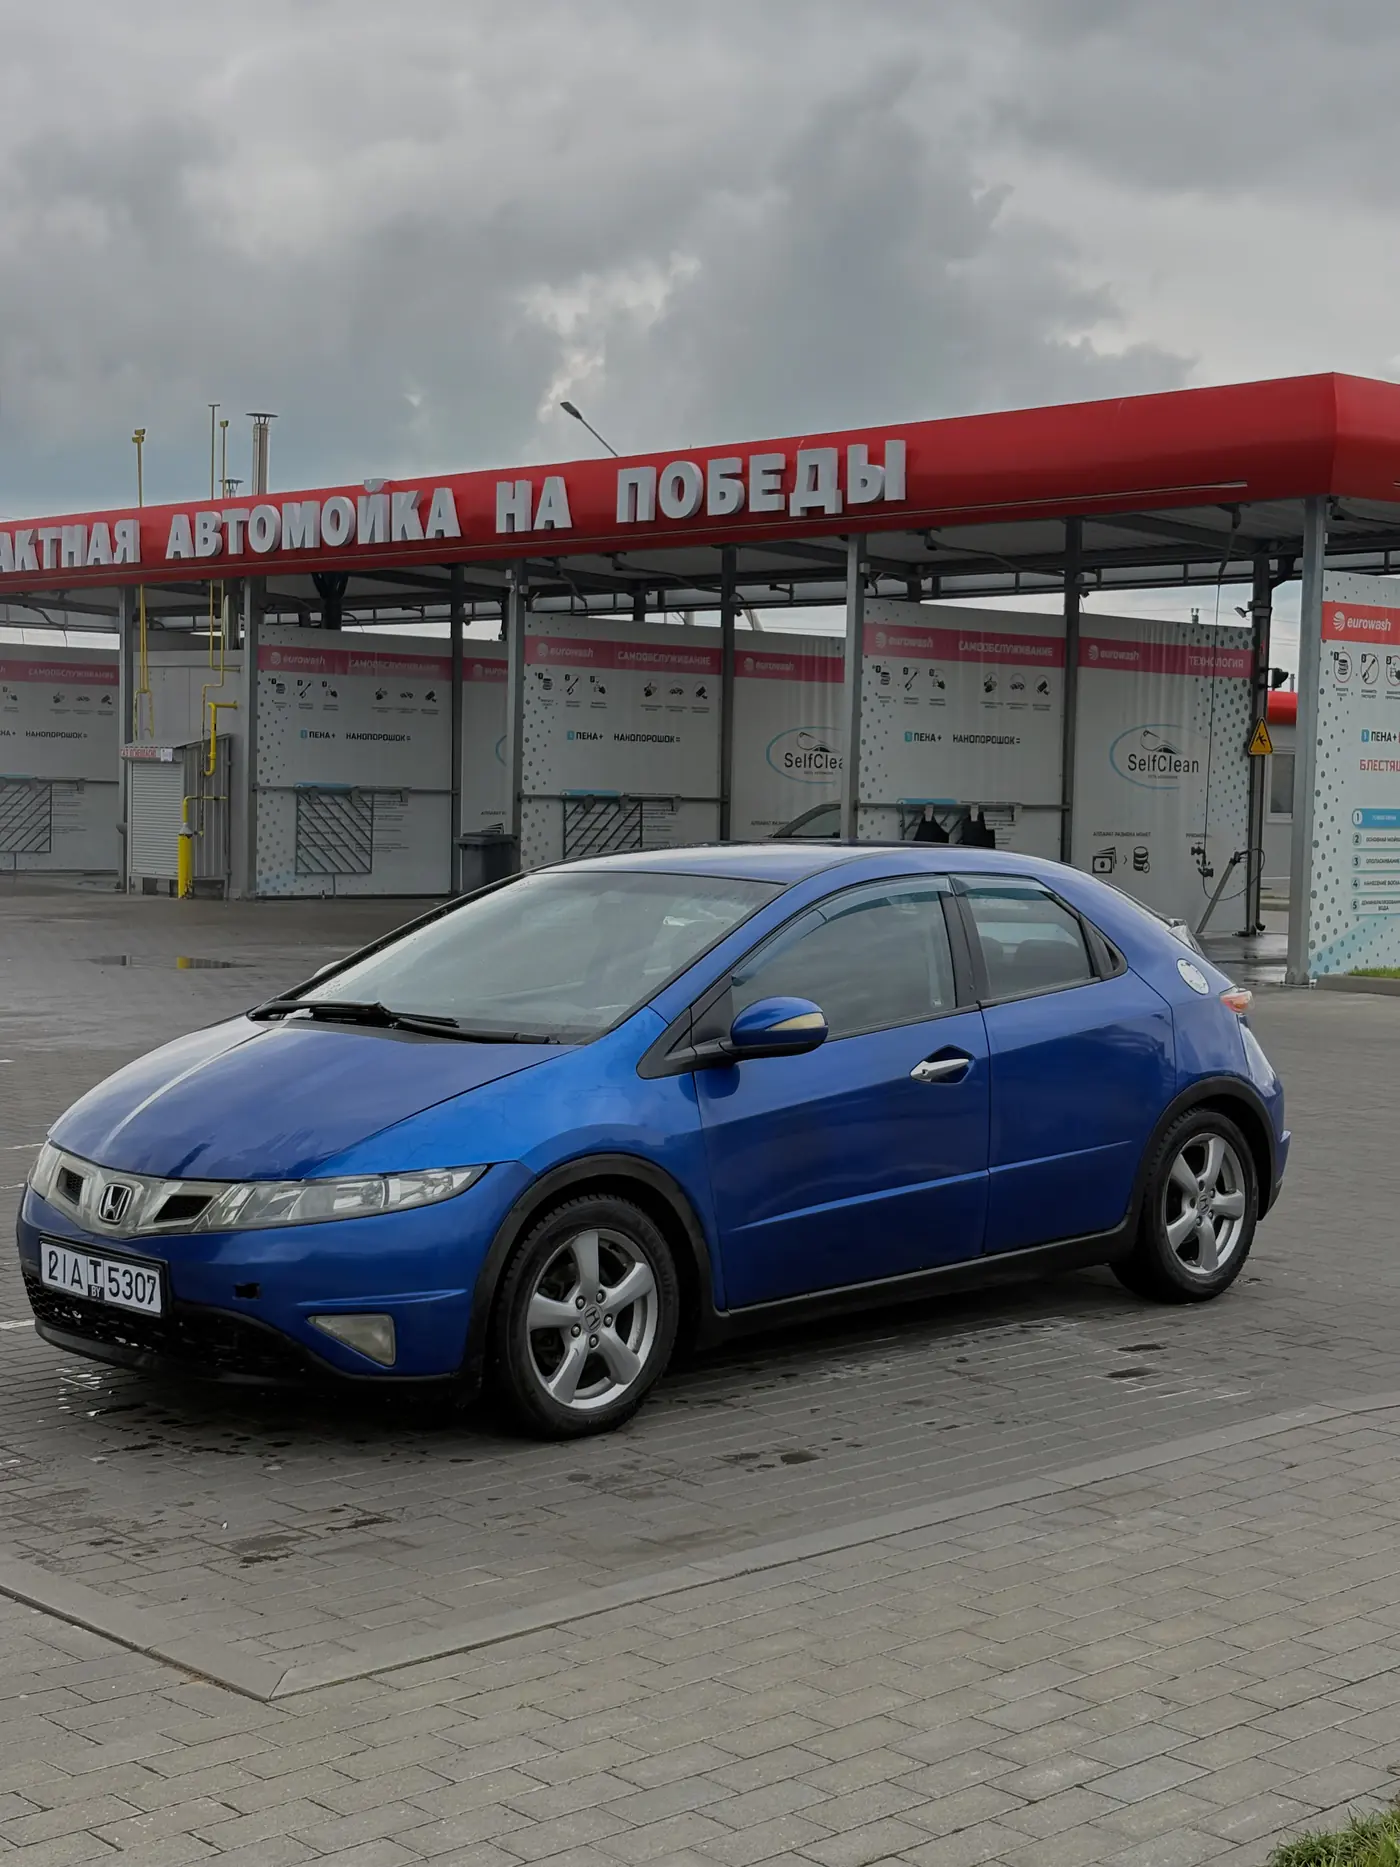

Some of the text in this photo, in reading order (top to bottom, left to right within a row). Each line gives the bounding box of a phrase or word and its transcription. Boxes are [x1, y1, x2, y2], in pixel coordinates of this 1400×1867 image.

[0, 439, 907, 573] АКТНАЯ АВТОМОЙКА НА ПОБЕДЫ
[1347, 617, 1392, 632] eurowash
[1100, 650, 1140, 661] eurowash
[1188, 655, 1244, 669] ТЕХНОЛОГИЯ
[1127, 753, 1200, 773] SelfClean
